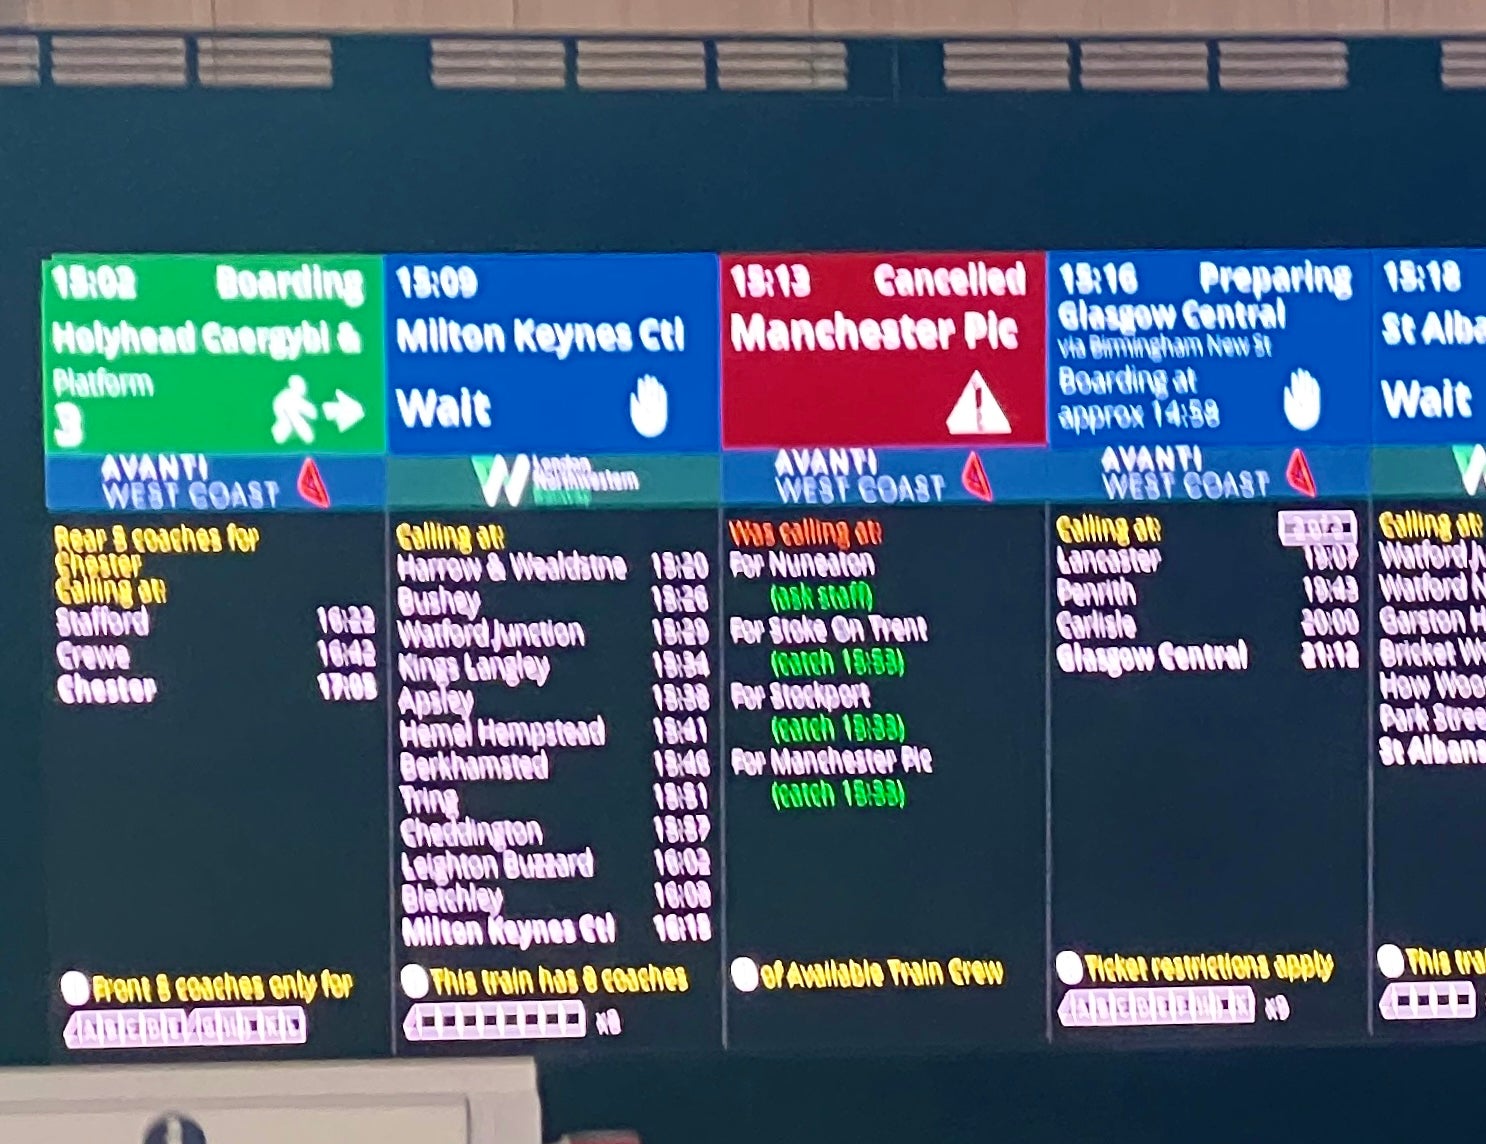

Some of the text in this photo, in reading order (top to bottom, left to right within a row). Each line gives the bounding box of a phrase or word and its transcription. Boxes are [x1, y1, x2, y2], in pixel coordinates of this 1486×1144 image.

[216, 264, 366, 308] Boarding
[874, 260, 1027, 297] Cancelled
[1200, 259, 1353, 301] Preparing
[731, 309, 1019, 352] Manchester Pic
[1058, 296, 1287, 337] Glasgow Central
[1381, 311, 1416, 345] St
[52, 320, 197, 361] Holyhead
[202, 320, 330, 361] Caergybi
[397, 316, 685, 360] Milton Keynes Ctl
[1057, 332, 1272, 363] via Birmingham New St
[53, 366, 155, 398] Platform
[1059, 364, 1199, 400] Boarding at
[1381, 378, 1472, 419] Wait
[395, 387, 491, 428] Wait
[1058, 403, 1145, 435] approx
[54, 402, 84, 448] 3
[101, 453, 208, 481] AVANTI
[775, 447, 878, 476] AVANTI
[1101, 444, 1202, 473] AVANTI
[102, 481, 280, 510] WEST COAST
[775, 474, 946, 505] WEST COAST
[1101, 470, 1270, 500] WEST COAST
[730, 551, 876, 578] For Nuneaton
[1378, 538, 1468, 569] Watford
[397, 585, 481, 621] Bushey
[1056, 576, 1137, 607] Penrith
[1378, 571, 1468, 602] Watford
[56, 605, 149, 637] Stafford
[396, 617, 586, 653] Watford Junction
[730, 615, 929, 644] For Stoke On Trent
[1056, 608, 1137, 640] Carlisle
[56, 641, 130, 670] Crewe
[398, 651, 550, 690] Kings Langley
[1056, 638, 1248, 678] Glasgow Central
[57, 672, 158, 704] Chester
[397, 686, 475, 722] Apsley
[730, 681, 872, 712] For Stockport
[400, 714, 606, 751] Hemel Hempstead
[400, 749, 550, 782] Berkhamsted
[1379, 736, 1405, 766] St
[399, 785, 459, 820] Tring
[400, 816, 544, 852] Cheddington
[401, 883, 504, 918] Bletchley
[761, 957, 1004, 990] of Available Train Crew
[1084, 949, 1335, 983] Ticket restrictions apply
